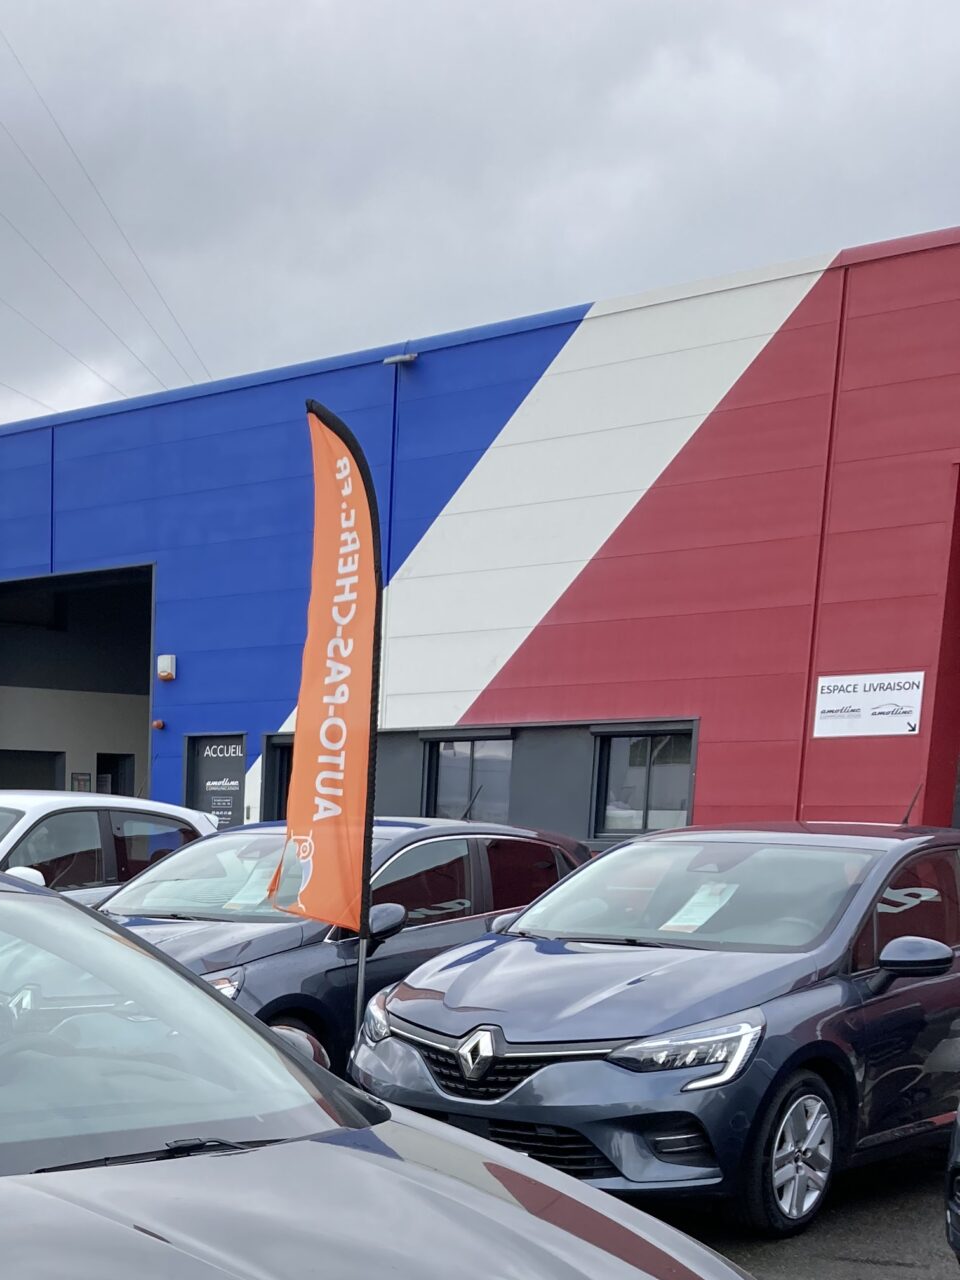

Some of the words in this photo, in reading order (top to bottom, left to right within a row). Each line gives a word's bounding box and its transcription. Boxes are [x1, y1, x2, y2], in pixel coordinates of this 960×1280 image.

[820, 684, 858, 694] ESPACE
[863, 681, 920, 692] LIVRAISON
[204, 745, 243, 757] ACCUEIL
